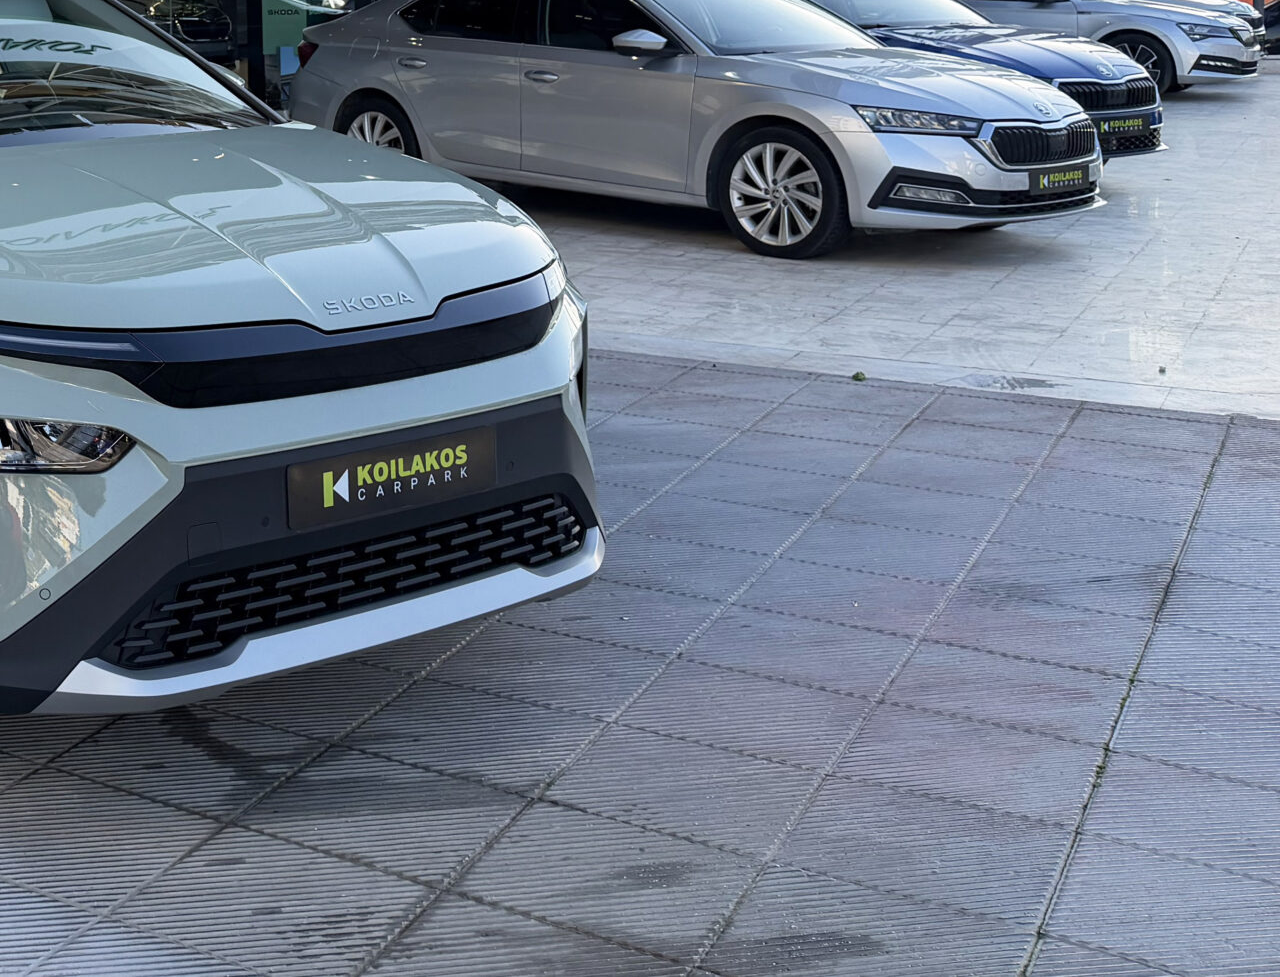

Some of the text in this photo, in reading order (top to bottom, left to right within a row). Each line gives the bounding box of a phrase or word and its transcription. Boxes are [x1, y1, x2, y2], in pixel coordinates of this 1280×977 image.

[322, 290, 415, 316] SKODA
[356, 444, 468, 487] KOILAKOS
[357, 466, 468, 501] CARPARK
